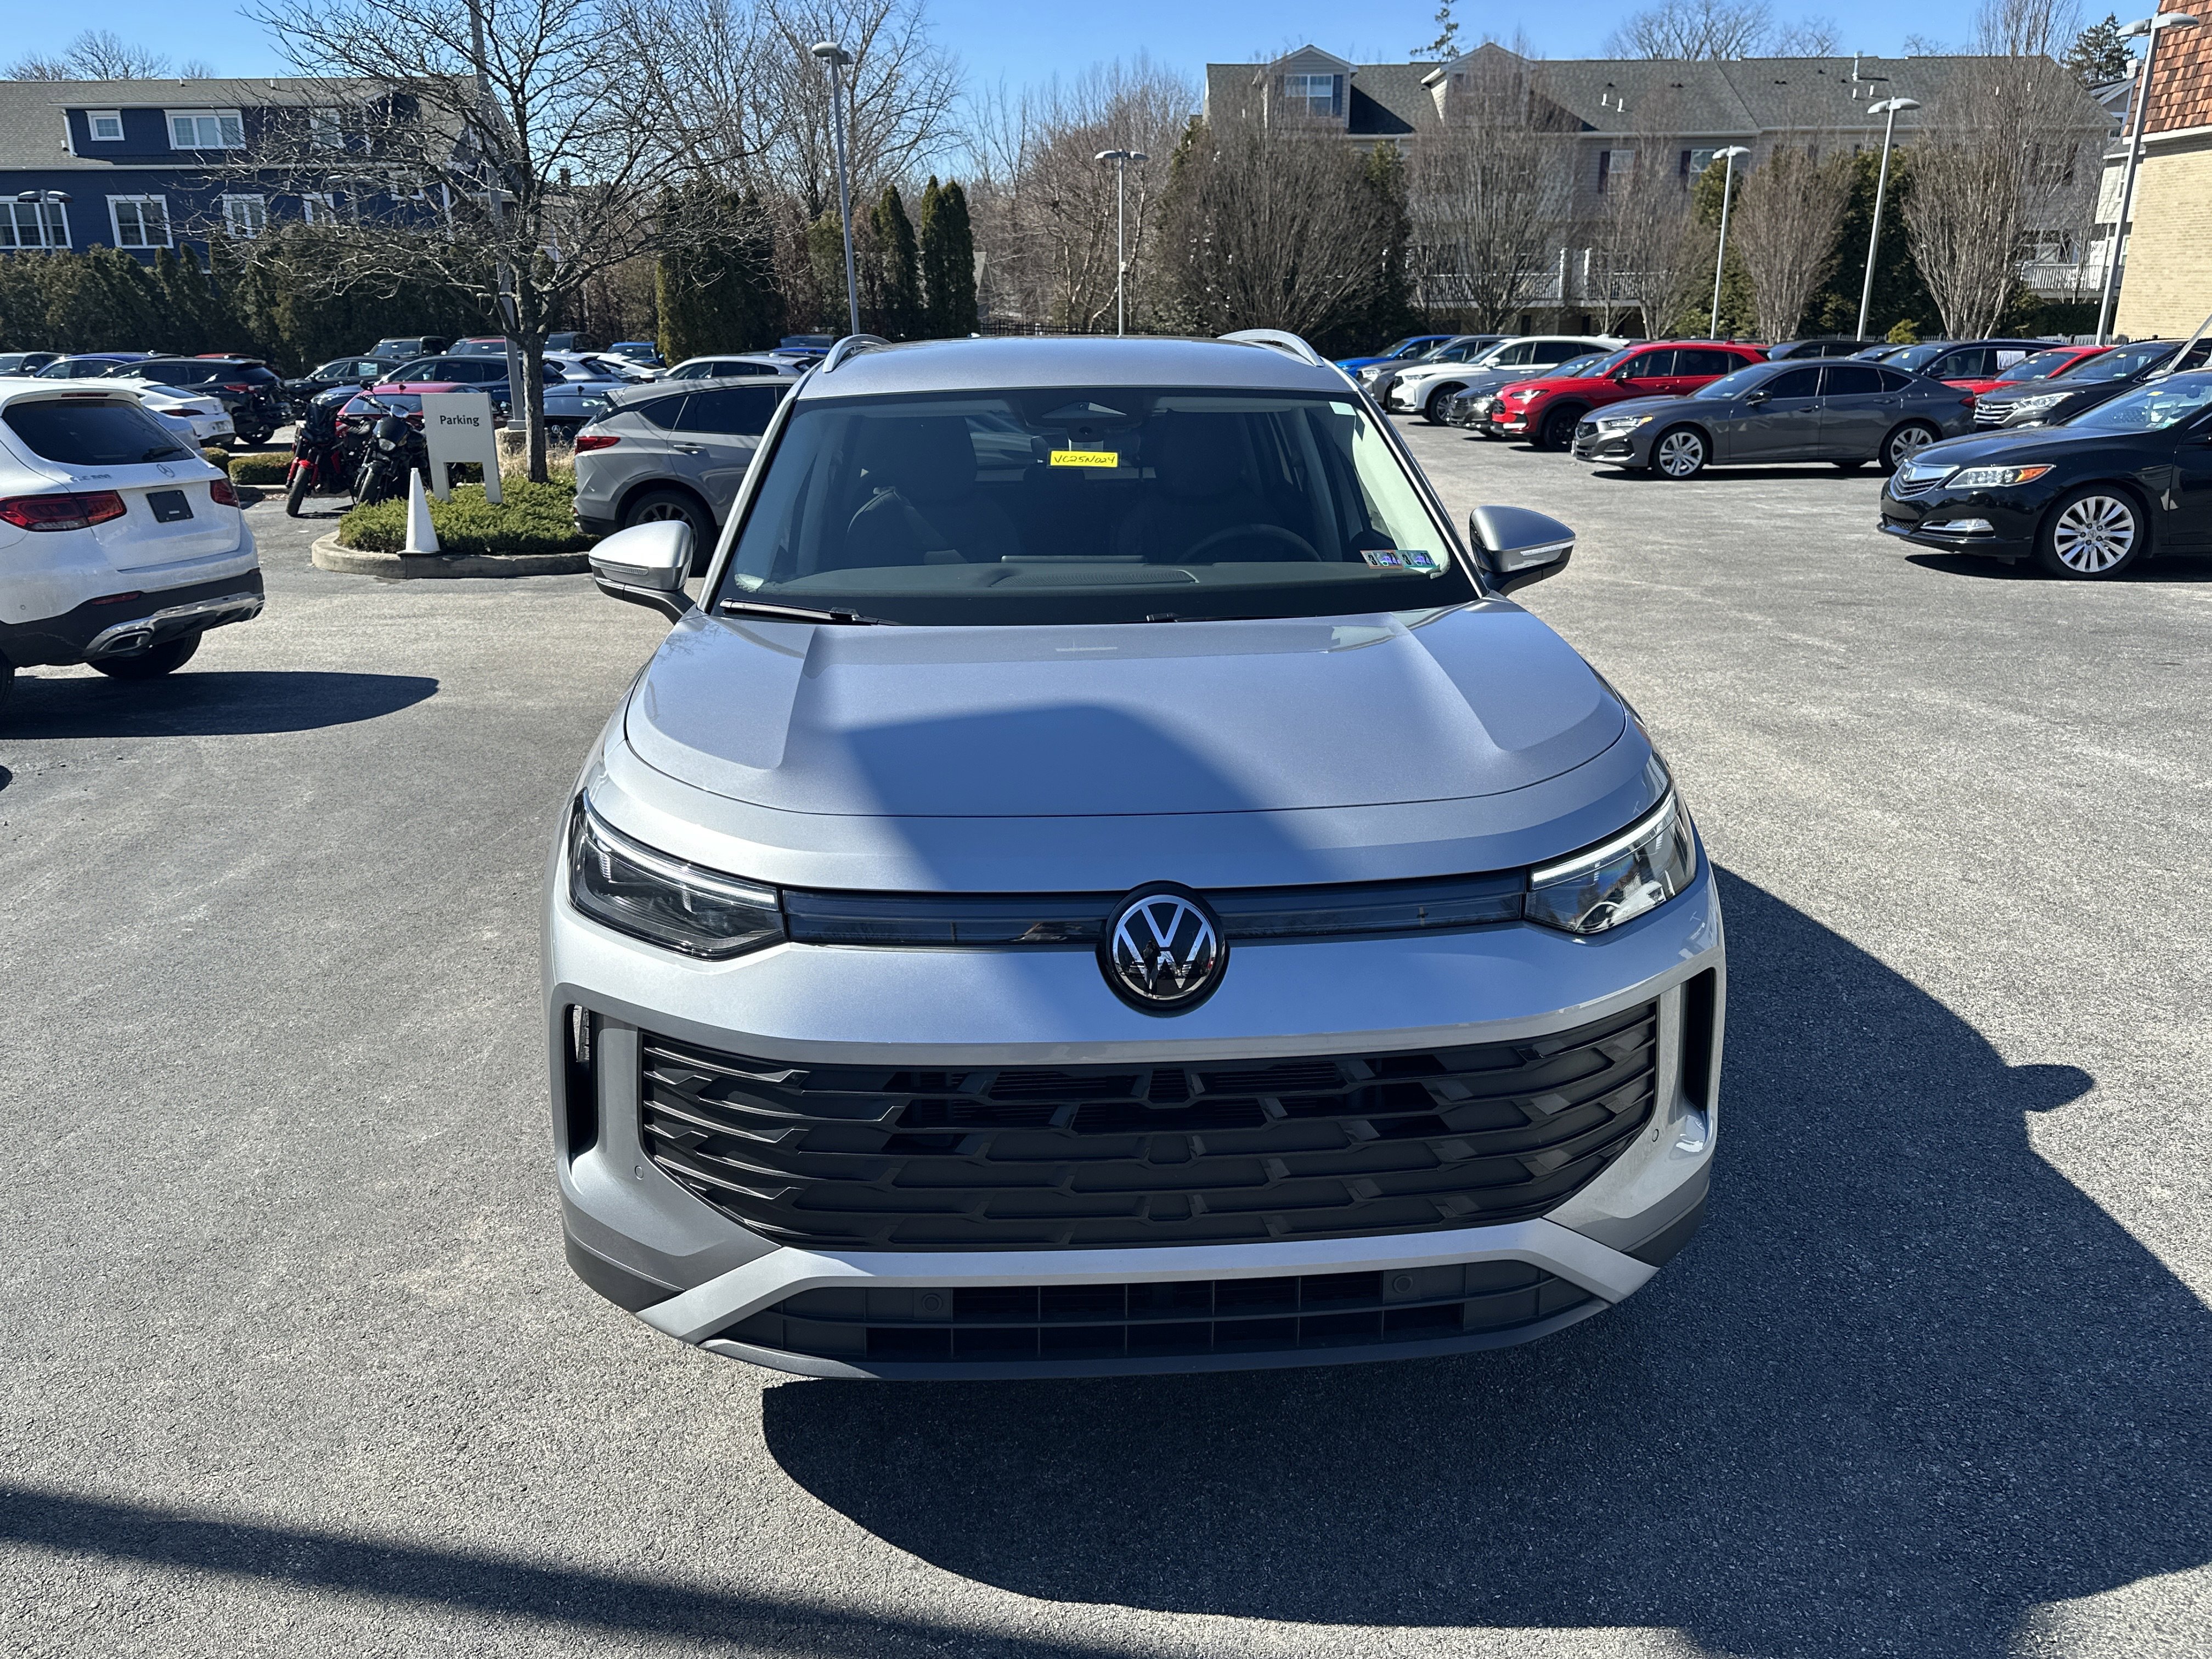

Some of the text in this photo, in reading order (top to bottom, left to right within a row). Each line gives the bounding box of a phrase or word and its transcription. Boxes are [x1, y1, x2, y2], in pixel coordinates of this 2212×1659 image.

[439, 415, 479, 427] Parking
[1368, 554, 1378, 566] 3
[1402, 554, 1412, 566] 3
[1114, 896, 1215, 998] VW
